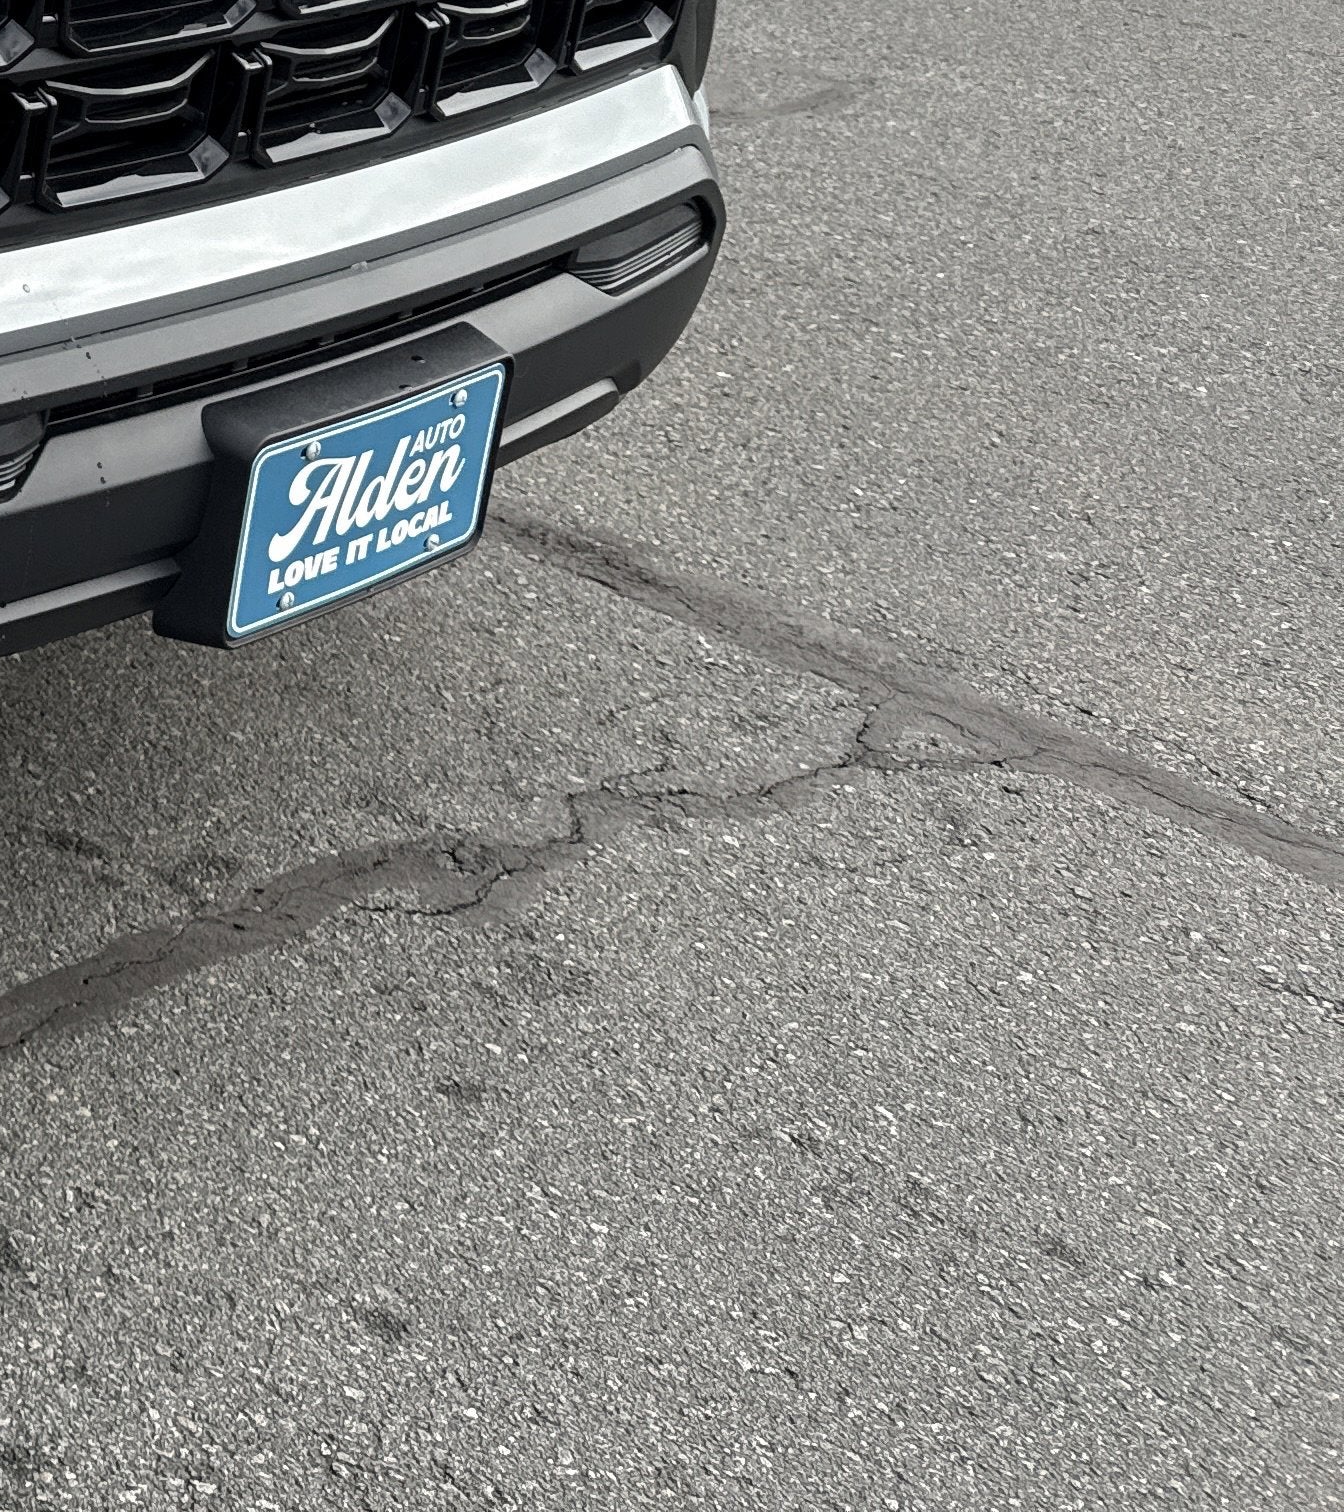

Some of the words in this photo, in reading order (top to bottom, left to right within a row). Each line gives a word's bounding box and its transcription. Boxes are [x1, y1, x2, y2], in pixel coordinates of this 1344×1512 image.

[409, 413, 466, 458] AUTO
[268, 434, 466, 563] Alden
[267, 548, 338, 595] LOVE
[345, 534, 375, 566] IT
[375, 500, 454, 554] LOCAL
